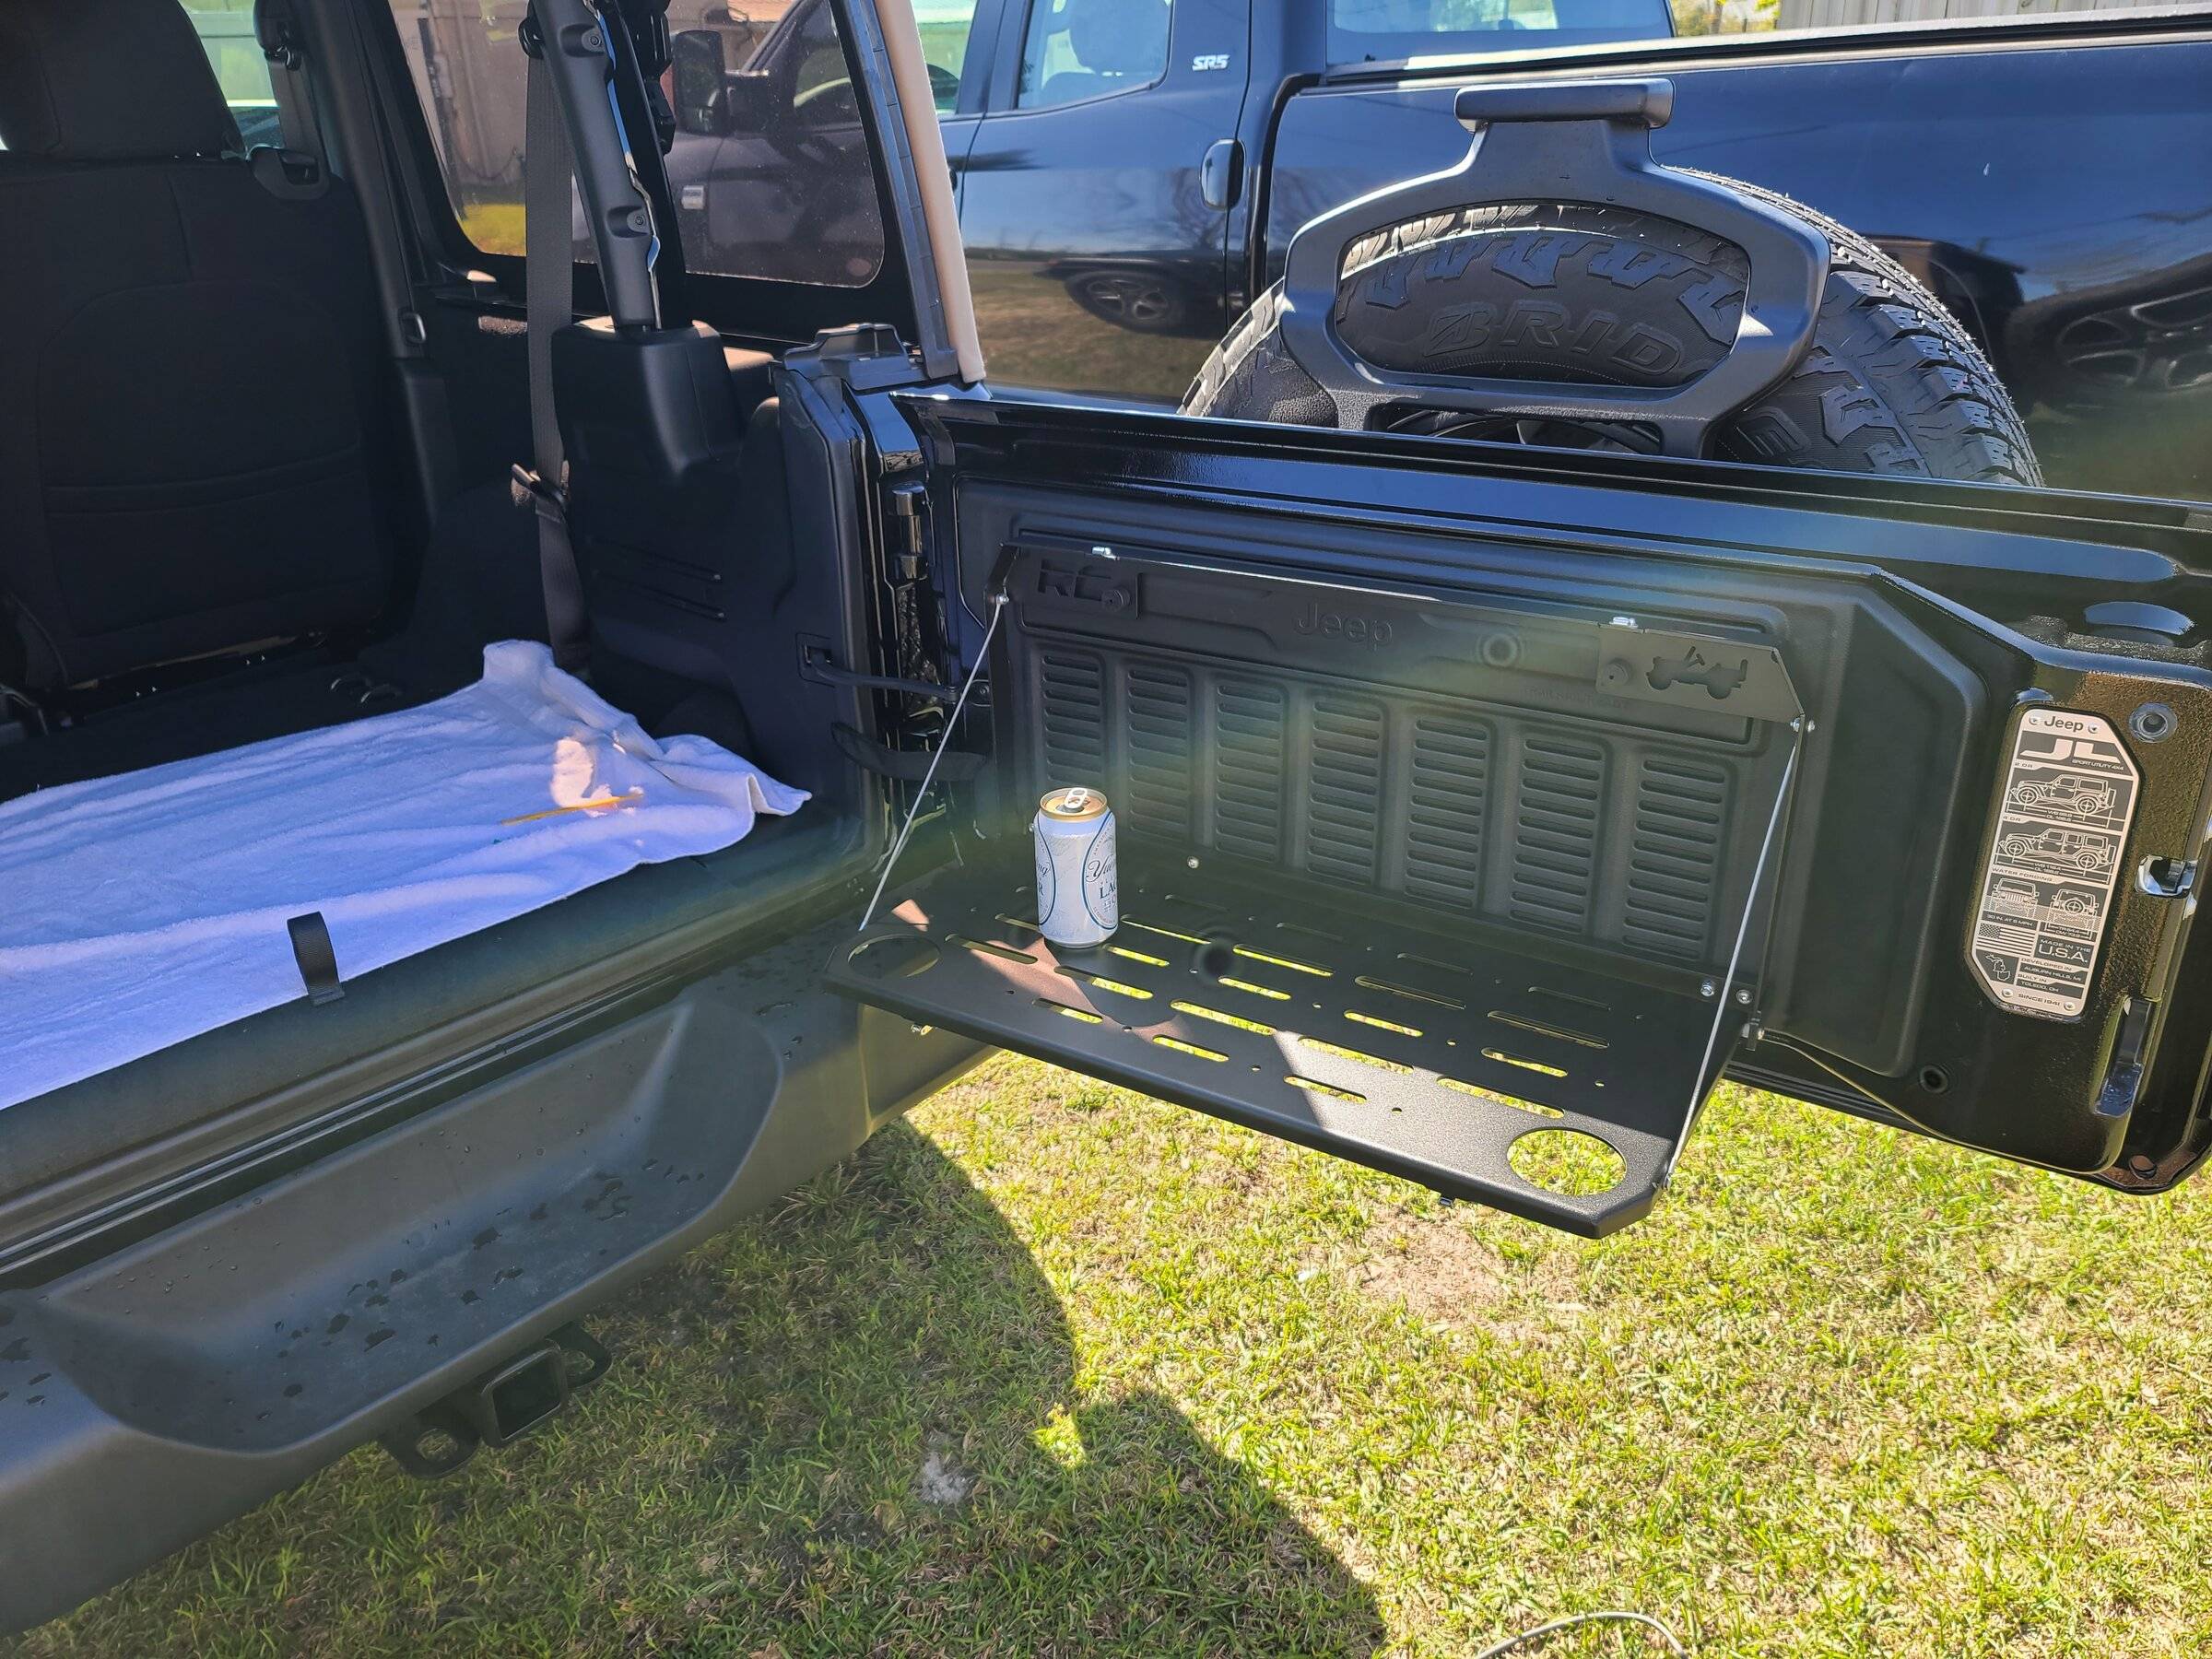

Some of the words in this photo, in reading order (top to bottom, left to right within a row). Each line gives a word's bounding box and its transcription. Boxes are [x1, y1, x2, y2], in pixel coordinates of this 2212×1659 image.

[1192, 54, 1230, 71] SR5
[1424, 300, 1685, 376] BRID
[1293, 602, 1394, 653] Jeep
[2044, 715, 2085, 733] Jeep
[2020, 738, 2121, 764] JL
[1992, 867, 2018, 876] WATER
[2019, 872, 2053, 882] FORDING
[2041, 939, 2064, 947] MADE
[2039, 943, 2088, 963] U.S.A.
[2021, 958, 2064, 970] DEVELOPED
[2024, 966, 2051, 975] AUBURN
[2018, 993, 2043, 1003] SINCE
[2044, 998, 2061, 1006] 1941
